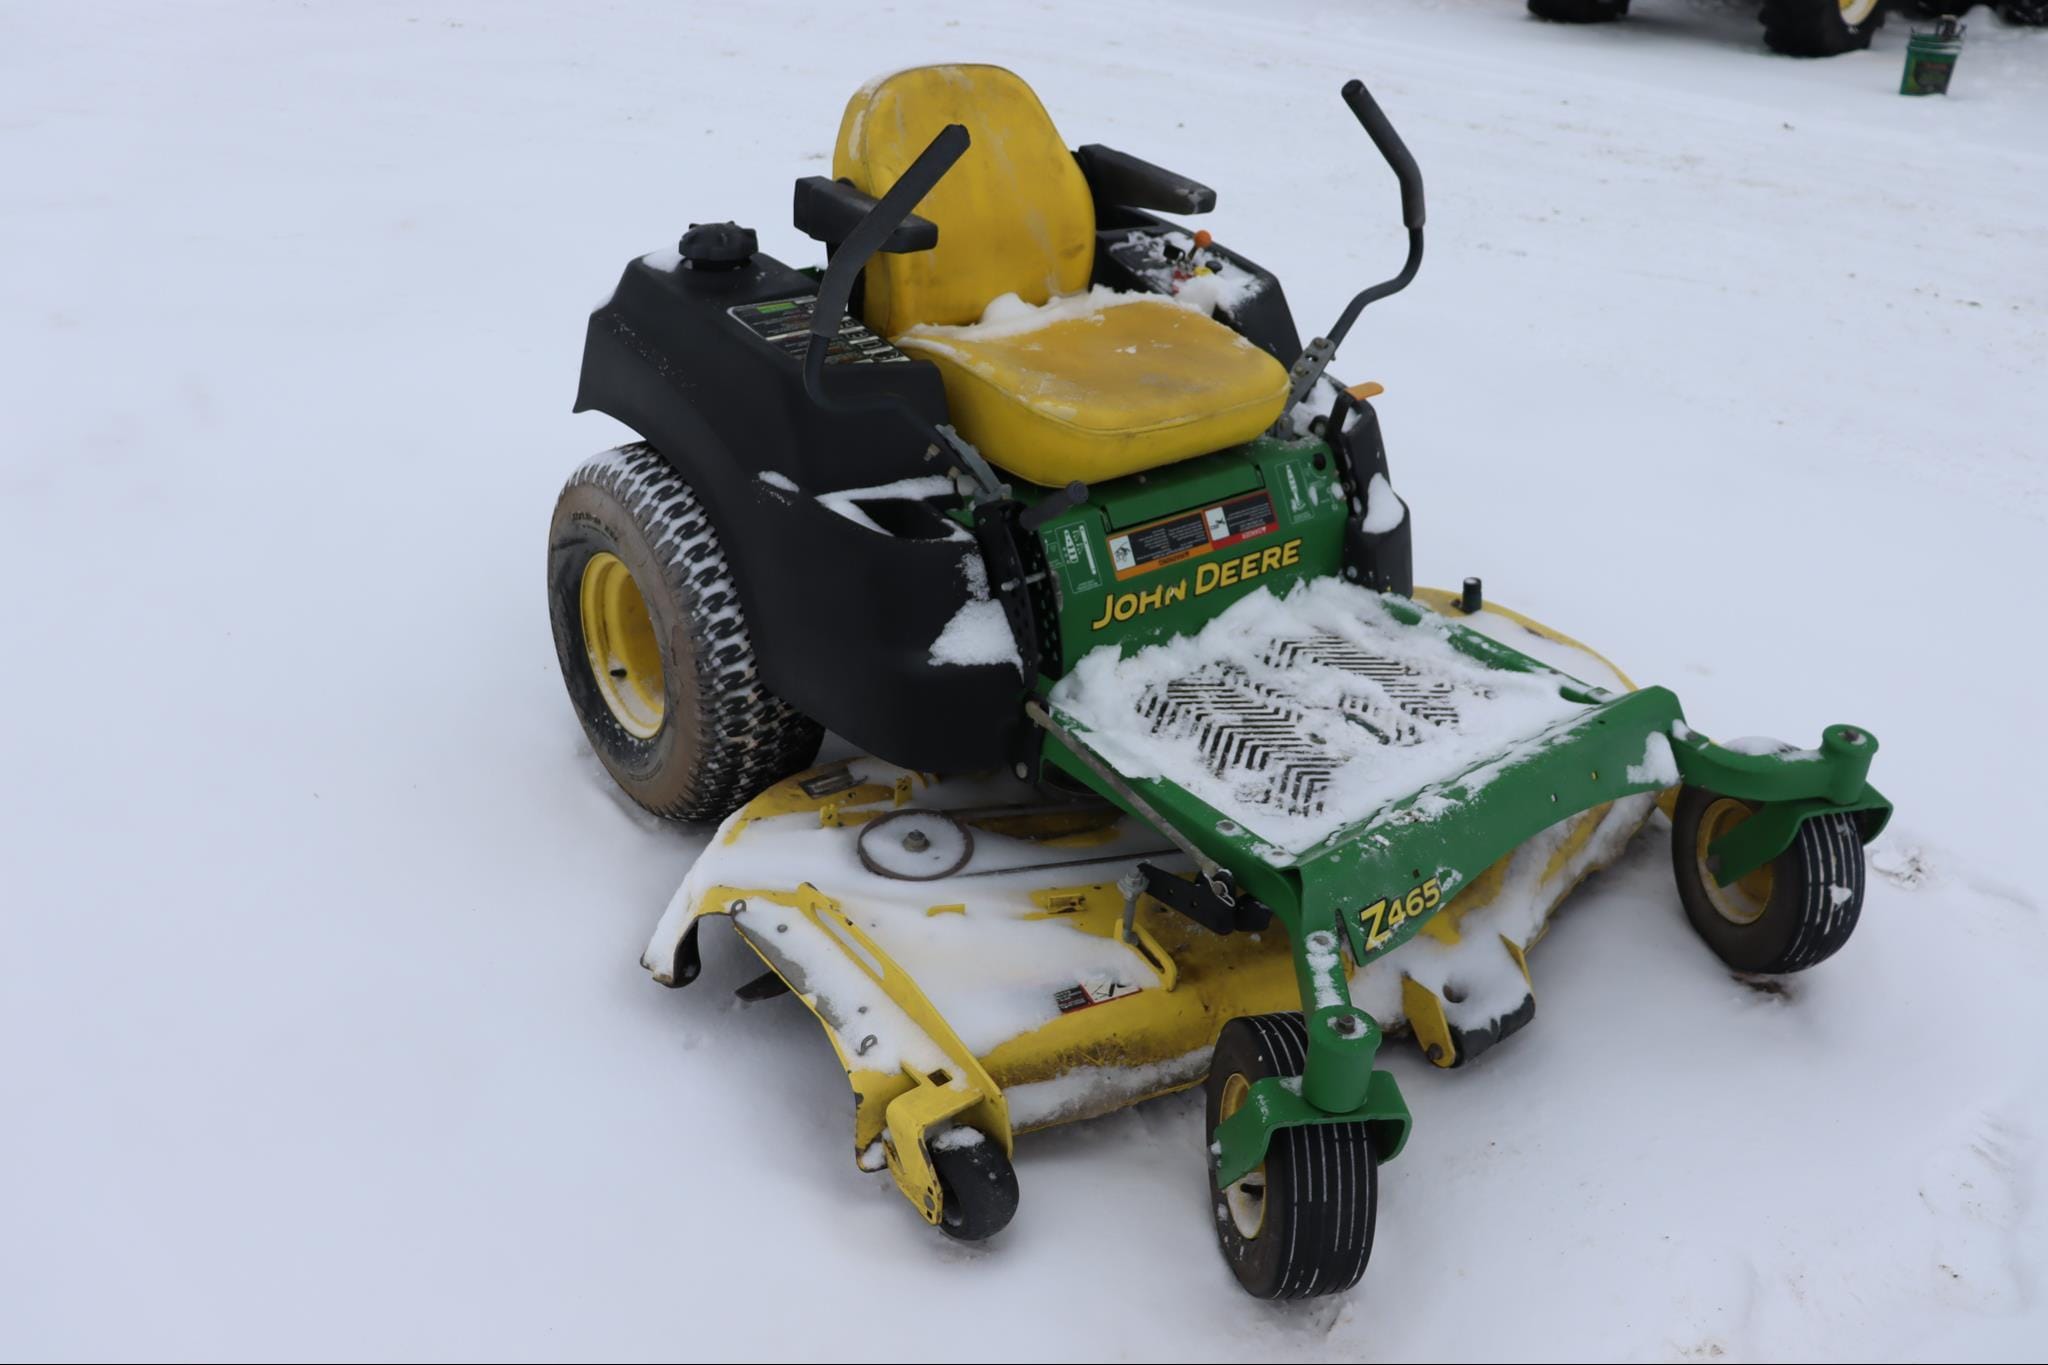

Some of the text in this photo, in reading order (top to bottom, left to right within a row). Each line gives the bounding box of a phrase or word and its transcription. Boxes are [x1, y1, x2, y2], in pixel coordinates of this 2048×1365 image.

[1091, 577, 1188, 631] JOHN
[1194, 538, 1302, 597] DEERE
[1359, 877, 1441, 952] Z465
